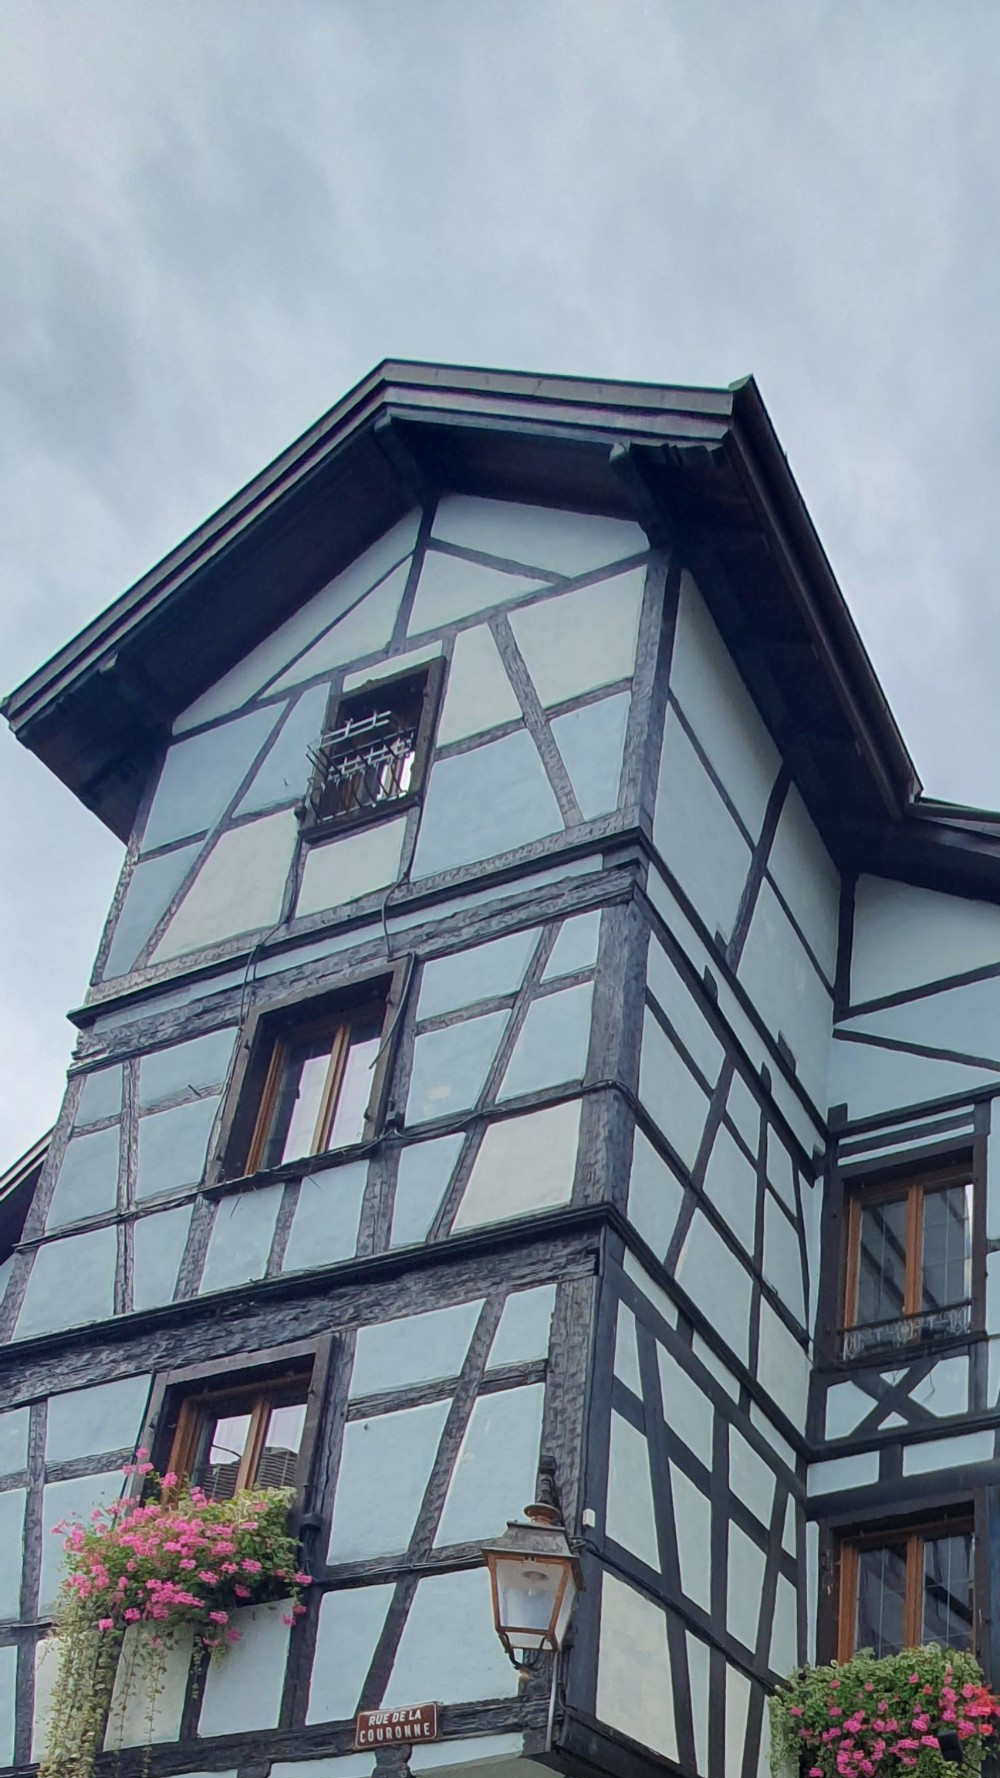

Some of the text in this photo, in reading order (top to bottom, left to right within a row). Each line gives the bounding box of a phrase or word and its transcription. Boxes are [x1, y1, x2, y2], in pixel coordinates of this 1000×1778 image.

[368, 1709, 421, 1727] RUE DE LA
[360, 1722, 430, 1743] COURONNE
